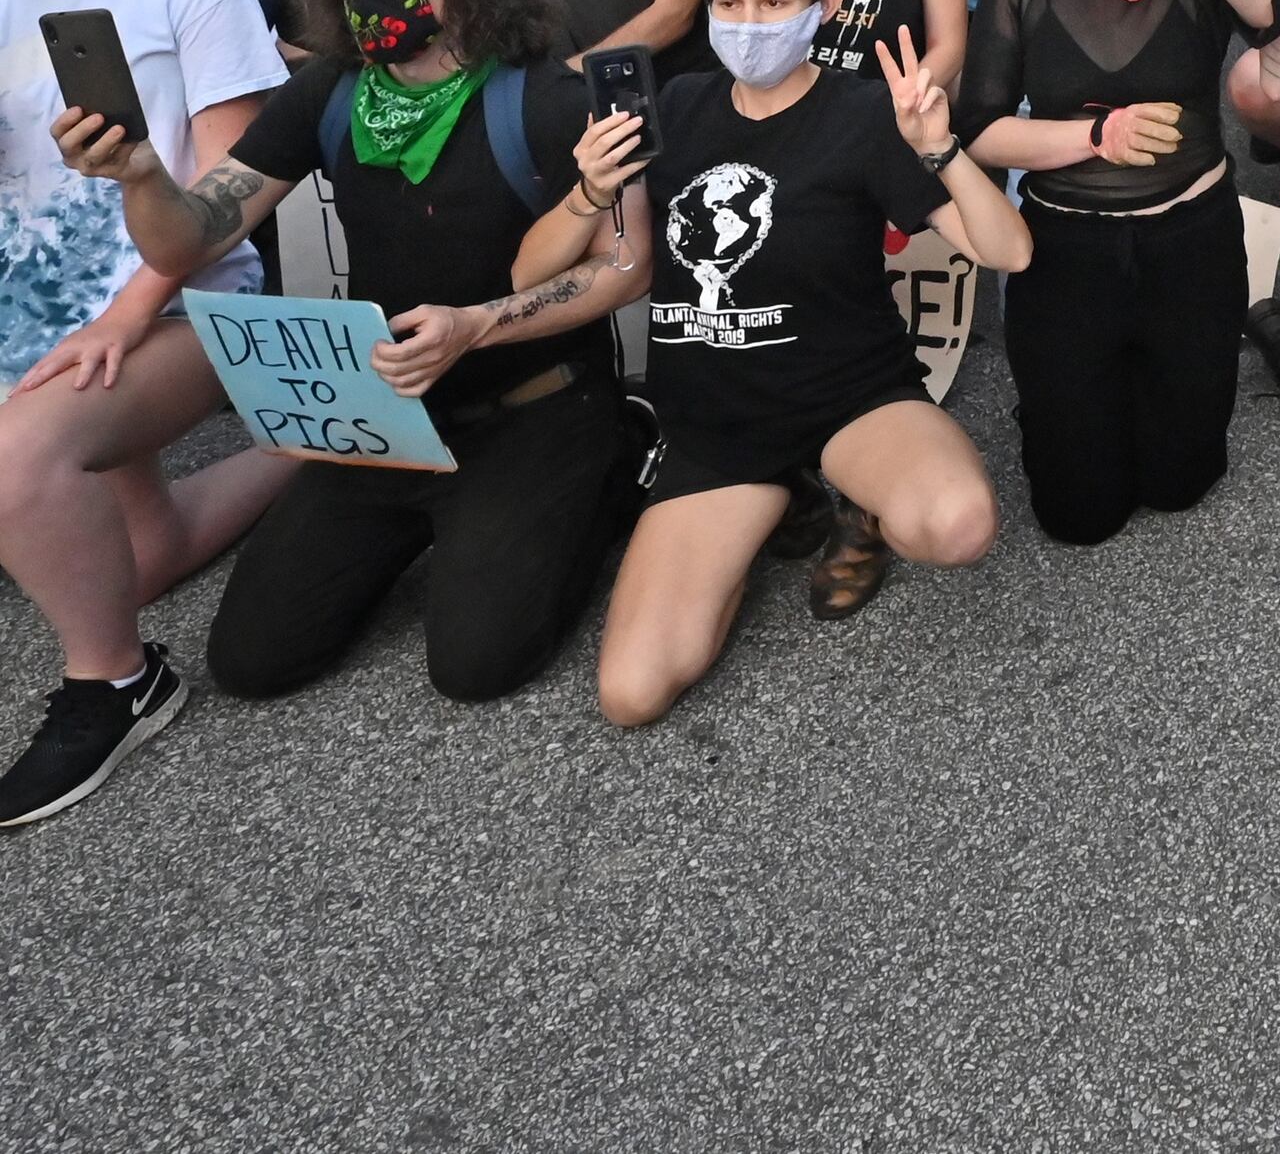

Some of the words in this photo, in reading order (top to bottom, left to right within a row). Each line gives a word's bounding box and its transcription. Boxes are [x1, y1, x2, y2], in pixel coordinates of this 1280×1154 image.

[652, 307, 696, 323] ATLANTA
[697, 311, 735, 329] ANIMAL
[738, 309, 783, 328] RIGHTS
[208, 313, 361, 372] DEATH
[684, 322, 715, 342] MARCH
[717, 329, 746, 344] 2019
[277, 377, 337, 406] TO
[253, 408, 391, 455] PIGS
